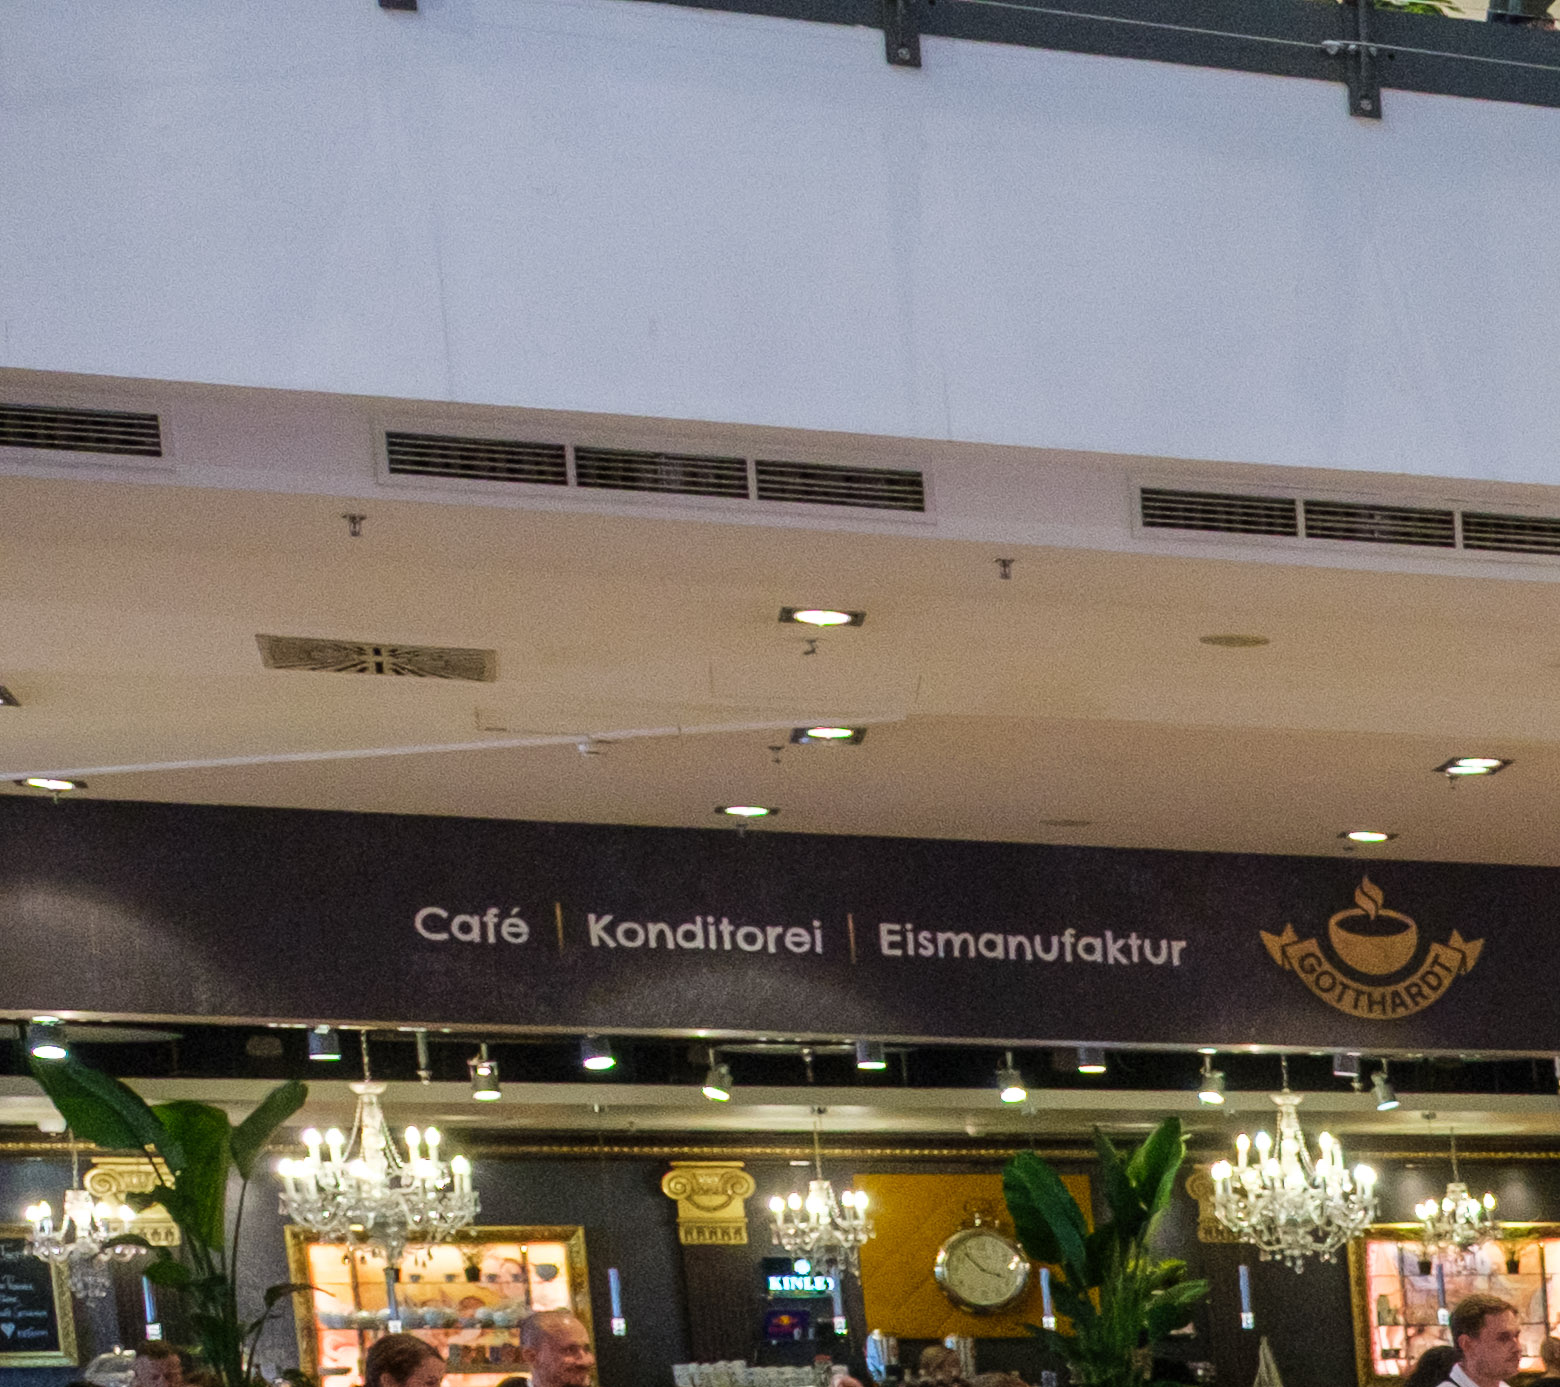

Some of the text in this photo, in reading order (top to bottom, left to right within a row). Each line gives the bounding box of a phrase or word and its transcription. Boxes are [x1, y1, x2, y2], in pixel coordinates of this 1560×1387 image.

[414, 905, 1188, 968] Café Konditorei Eismanufaktur
[1294, 950, 1456, 1017] GOTTHARDT
